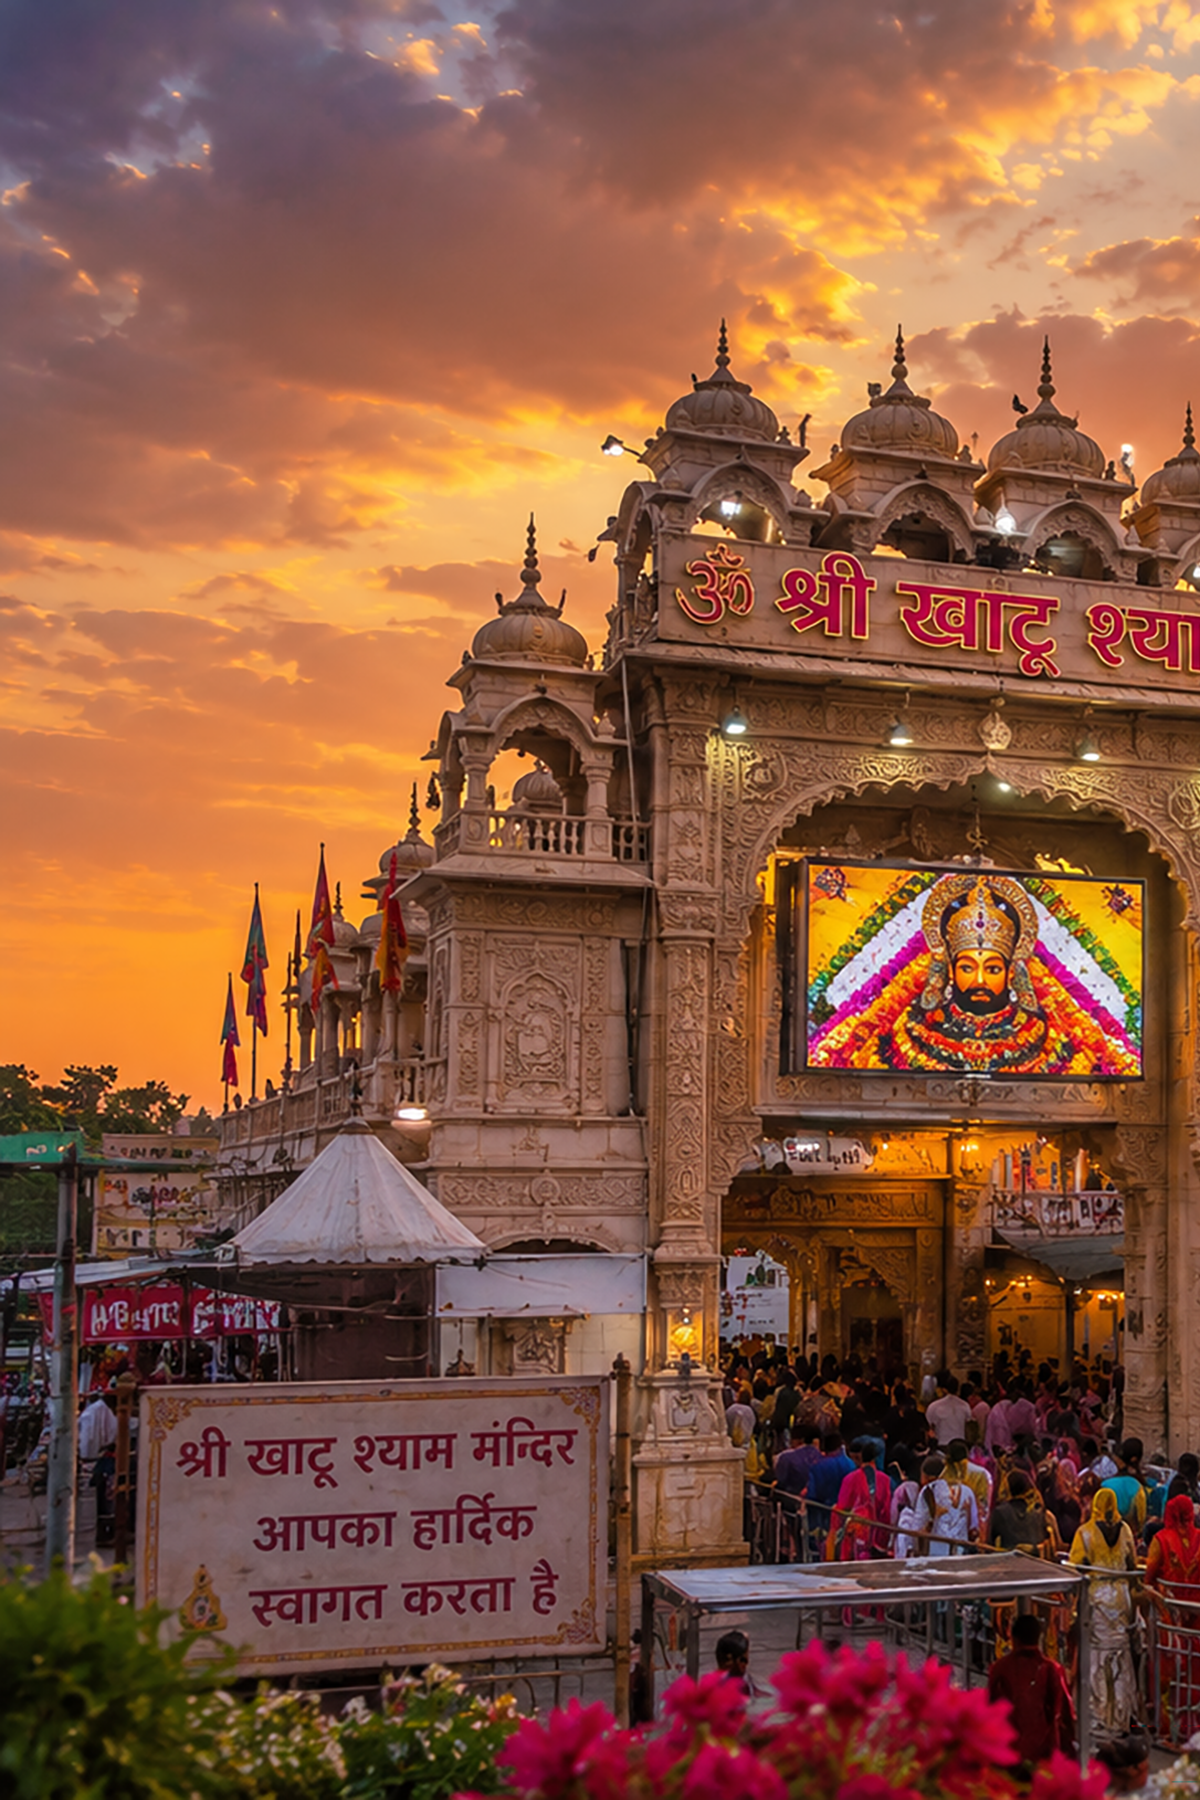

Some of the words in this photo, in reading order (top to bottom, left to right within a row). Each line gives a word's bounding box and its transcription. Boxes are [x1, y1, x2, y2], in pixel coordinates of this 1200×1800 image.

[776, 551, 876, 639] श्री
[897, 581, 1061, 678] खाटू
[176, 1426, 232, 1478] श्री
[244, 1437, 338, 1488] खाटू
[353, 1433, 458, 1474] श्याम
[252, 1511, 397, 1552] आपका
[410, 1492, 538, 1550] हार्दिक
[248, 1584, 388, 1627] स्वागत
[401, 1577, 516, 1616] करता
[530, 1558, 559, 1615] है
